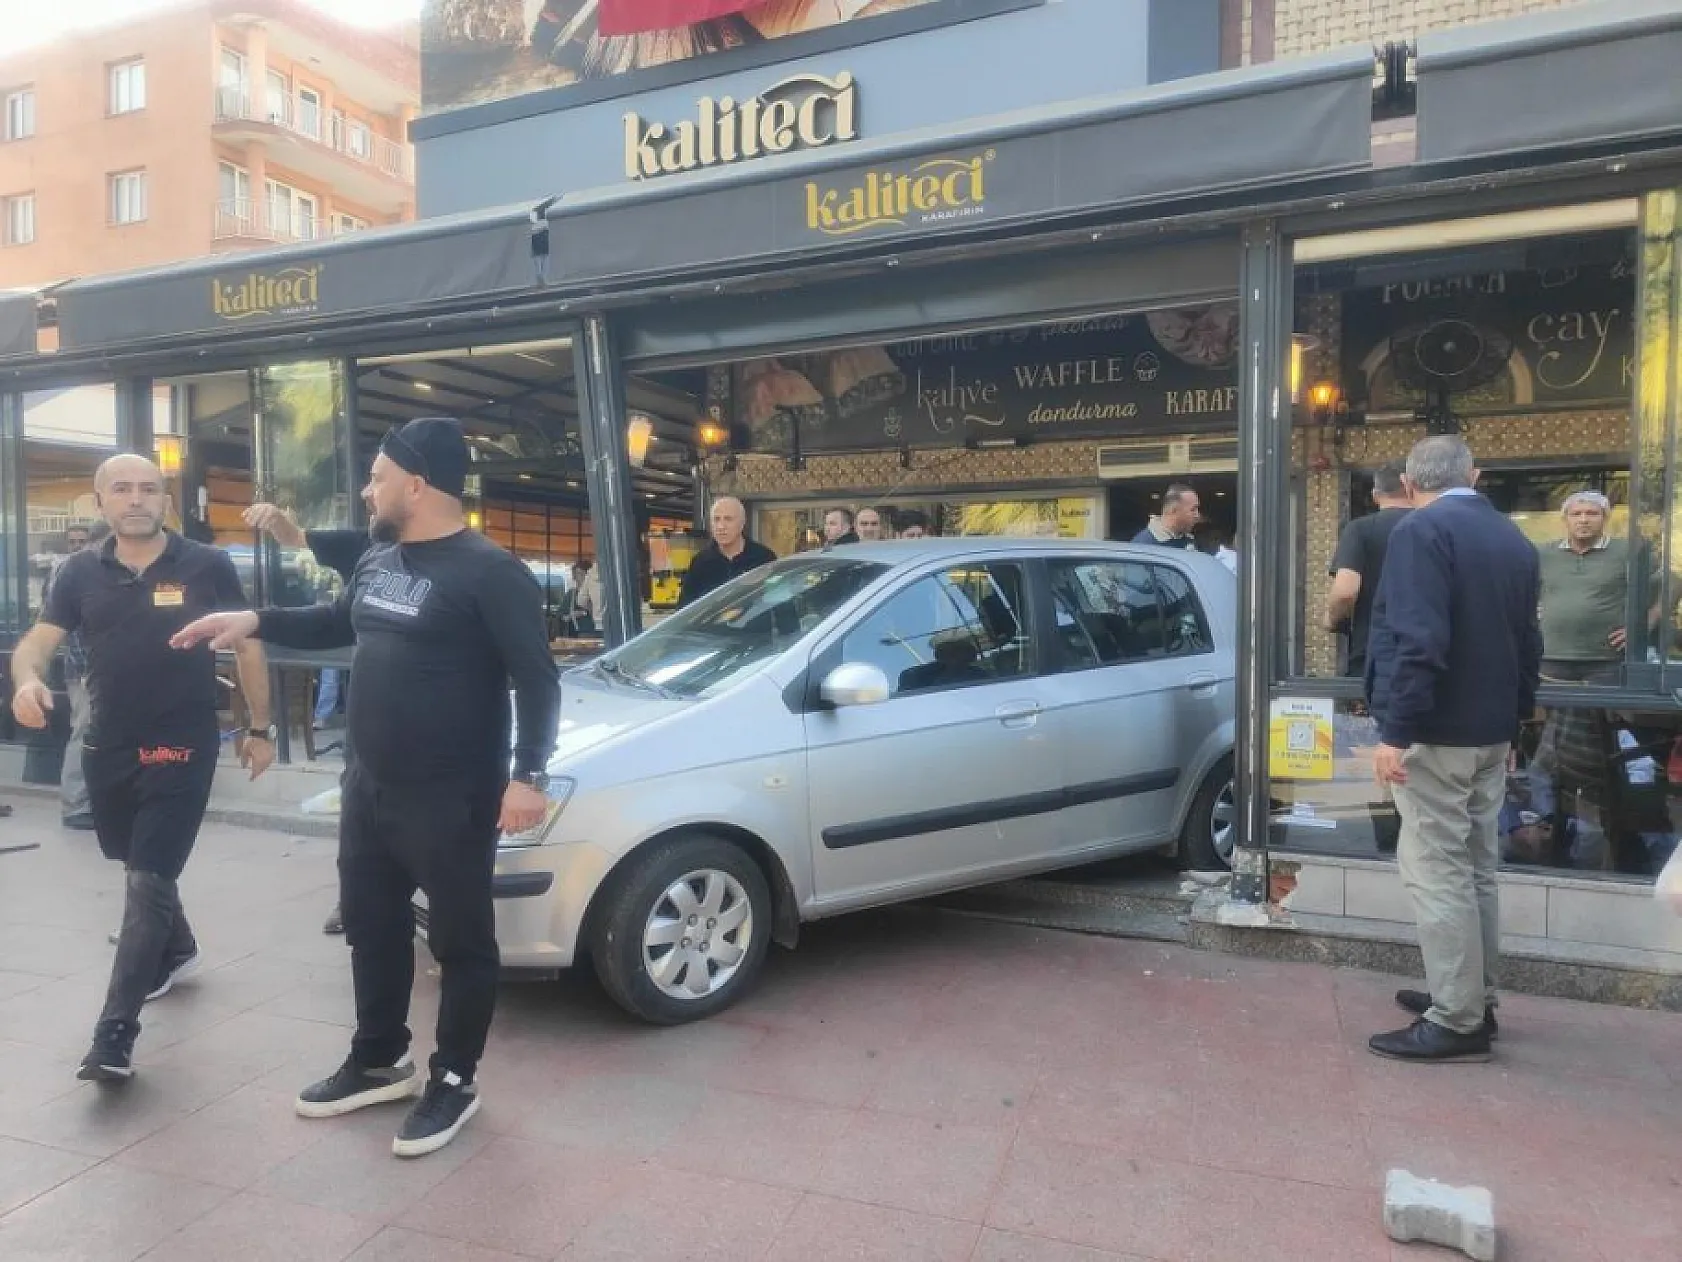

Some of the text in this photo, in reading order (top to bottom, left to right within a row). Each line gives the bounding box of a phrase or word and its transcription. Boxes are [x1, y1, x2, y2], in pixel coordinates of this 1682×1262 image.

[623, 70, 857, 180] kaliteci
[805, 156, 985, 234] kaliteci
[212, 267, 318, 320] kaliteci
[1013, 358, 1124, 389] WAFFLE
[1527, 307, 1619, 389] çay
[917, 365, 1005, 434] kahve
[1027, 399, 1138, 424] dondurma
